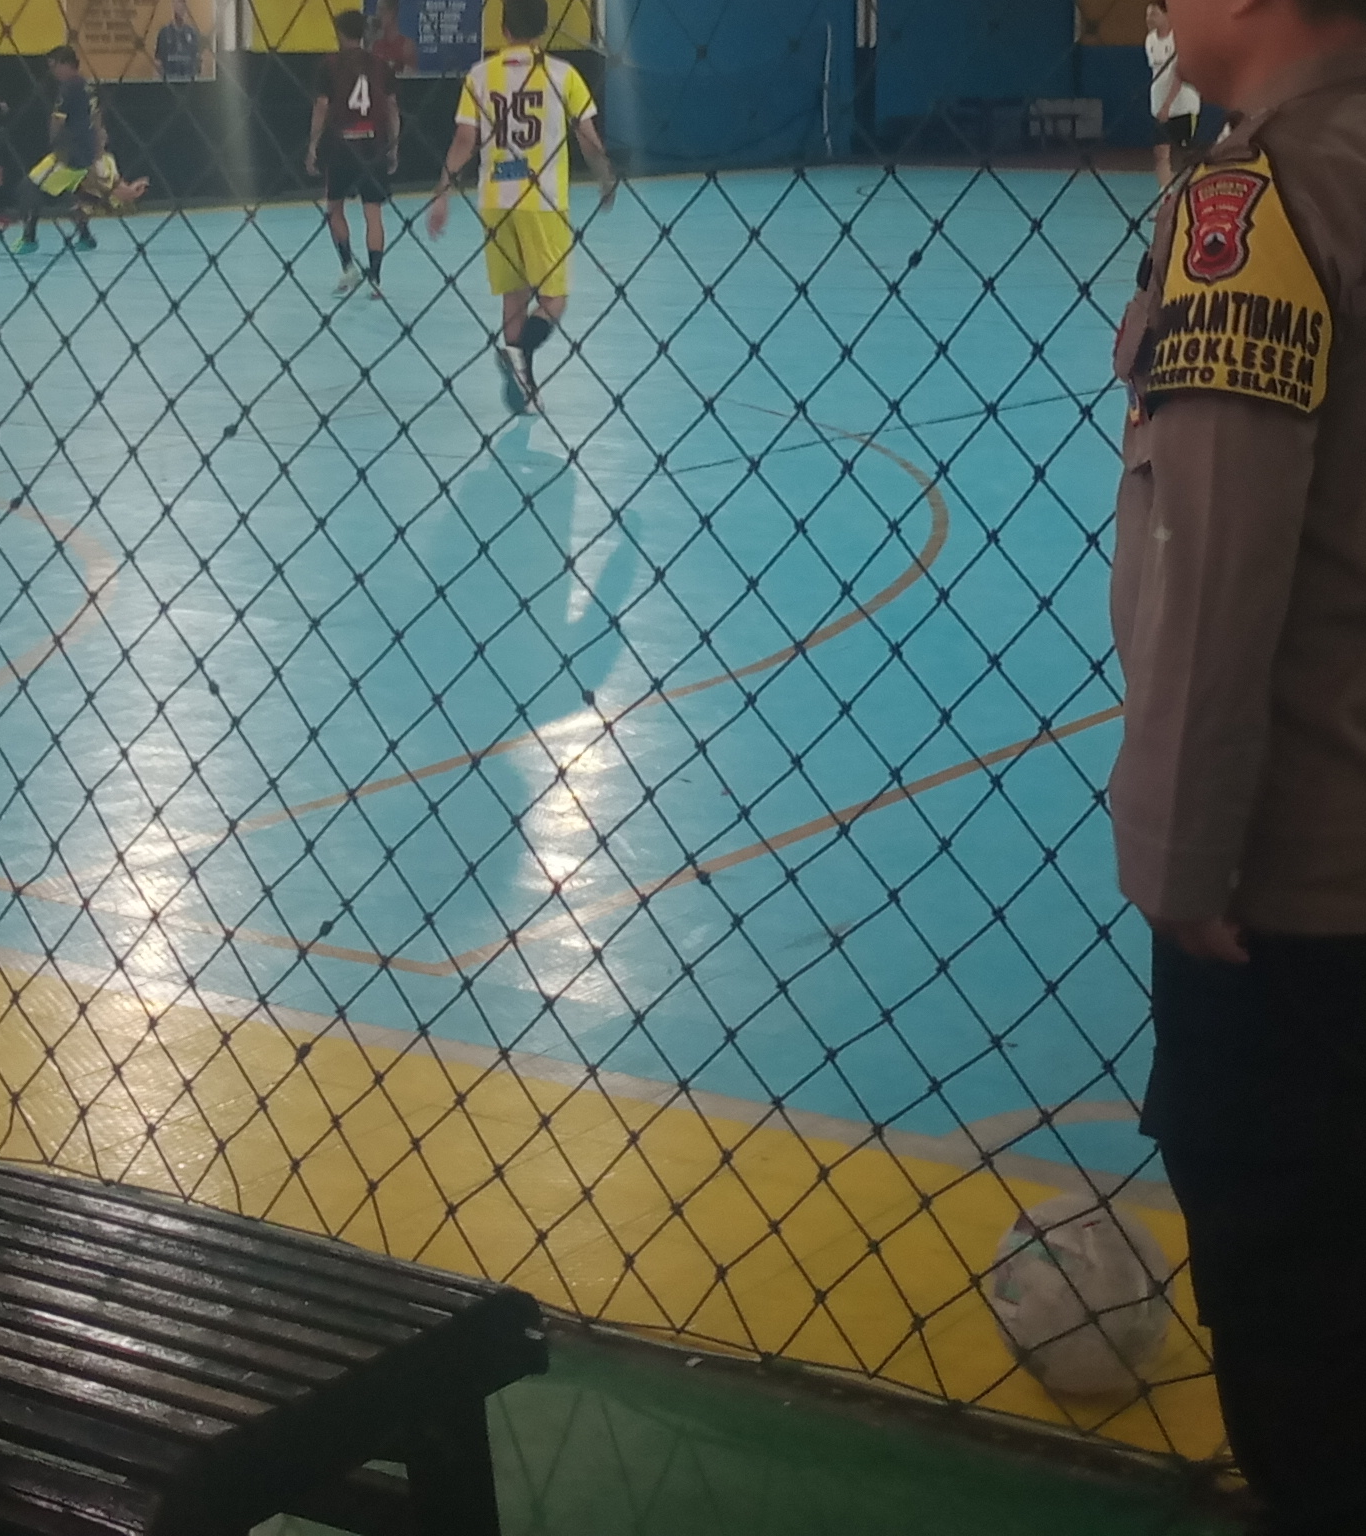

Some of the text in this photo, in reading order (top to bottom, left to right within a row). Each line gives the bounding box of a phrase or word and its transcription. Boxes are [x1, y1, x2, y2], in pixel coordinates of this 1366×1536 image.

[348, 74, 372, 116] 4
[490, 91, 544, 151] 15
[1227, 368, 1311, 407] SELATAN
